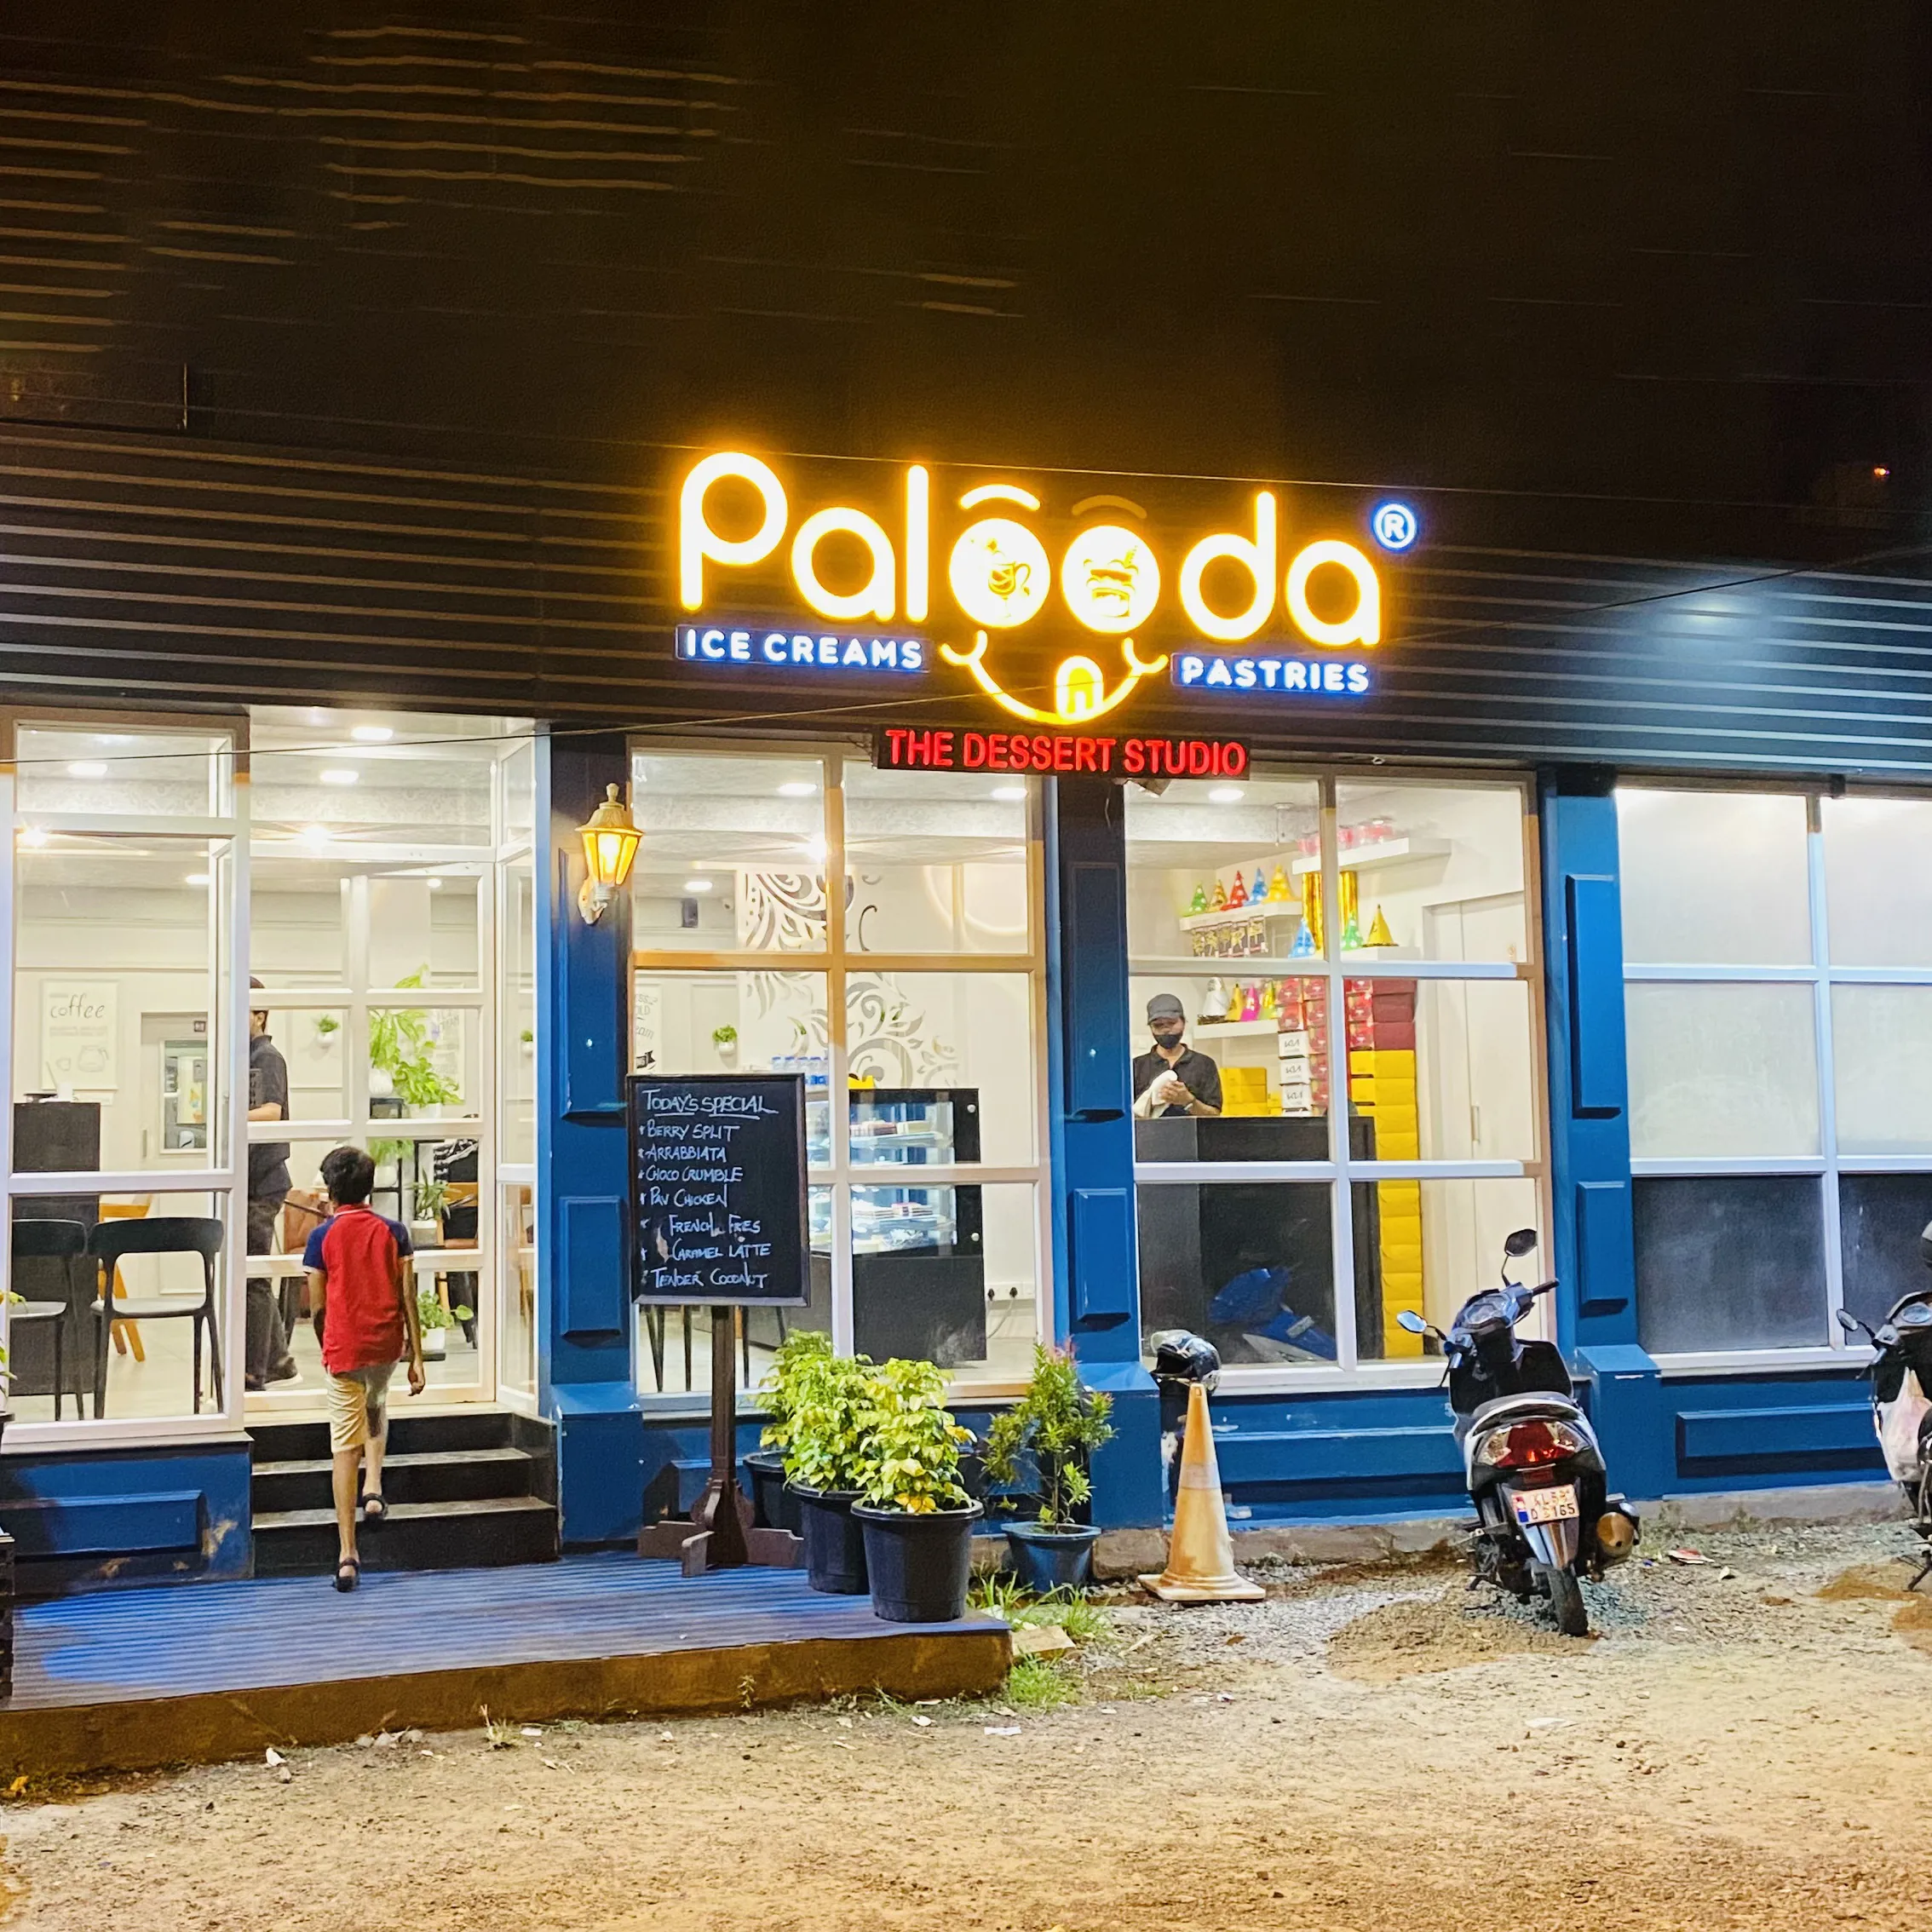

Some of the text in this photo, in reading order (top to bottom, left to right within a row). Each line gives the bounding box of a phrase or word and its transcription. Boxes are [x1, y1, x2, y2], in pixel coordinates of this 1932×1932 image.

[686, 628, 923, 670] ICE CREAMS
[1181, 656, 1369, 693] PASTRIES
[885, 728, 1247, 777] THE DESSERT STUDIO
[50, 992, 105, 1020] coffee
[699, 1095, 779, 1115] SPECIAL
[647, 1118, 741, 1142] BERRY SPLIT
[645, 1142, 727, 1163] ARRABBIATA
[645, 1164, 744, 1182] CHOCO CRUMBLE
[673, 1183, 727, 1208] CHICKEN
[669, 1210, 716, 1237] FRENCH
[671, 1237, 772, 1261] CARAMEL LATTE
[650, 1261, 768, 1289] TENDER COCONUT
